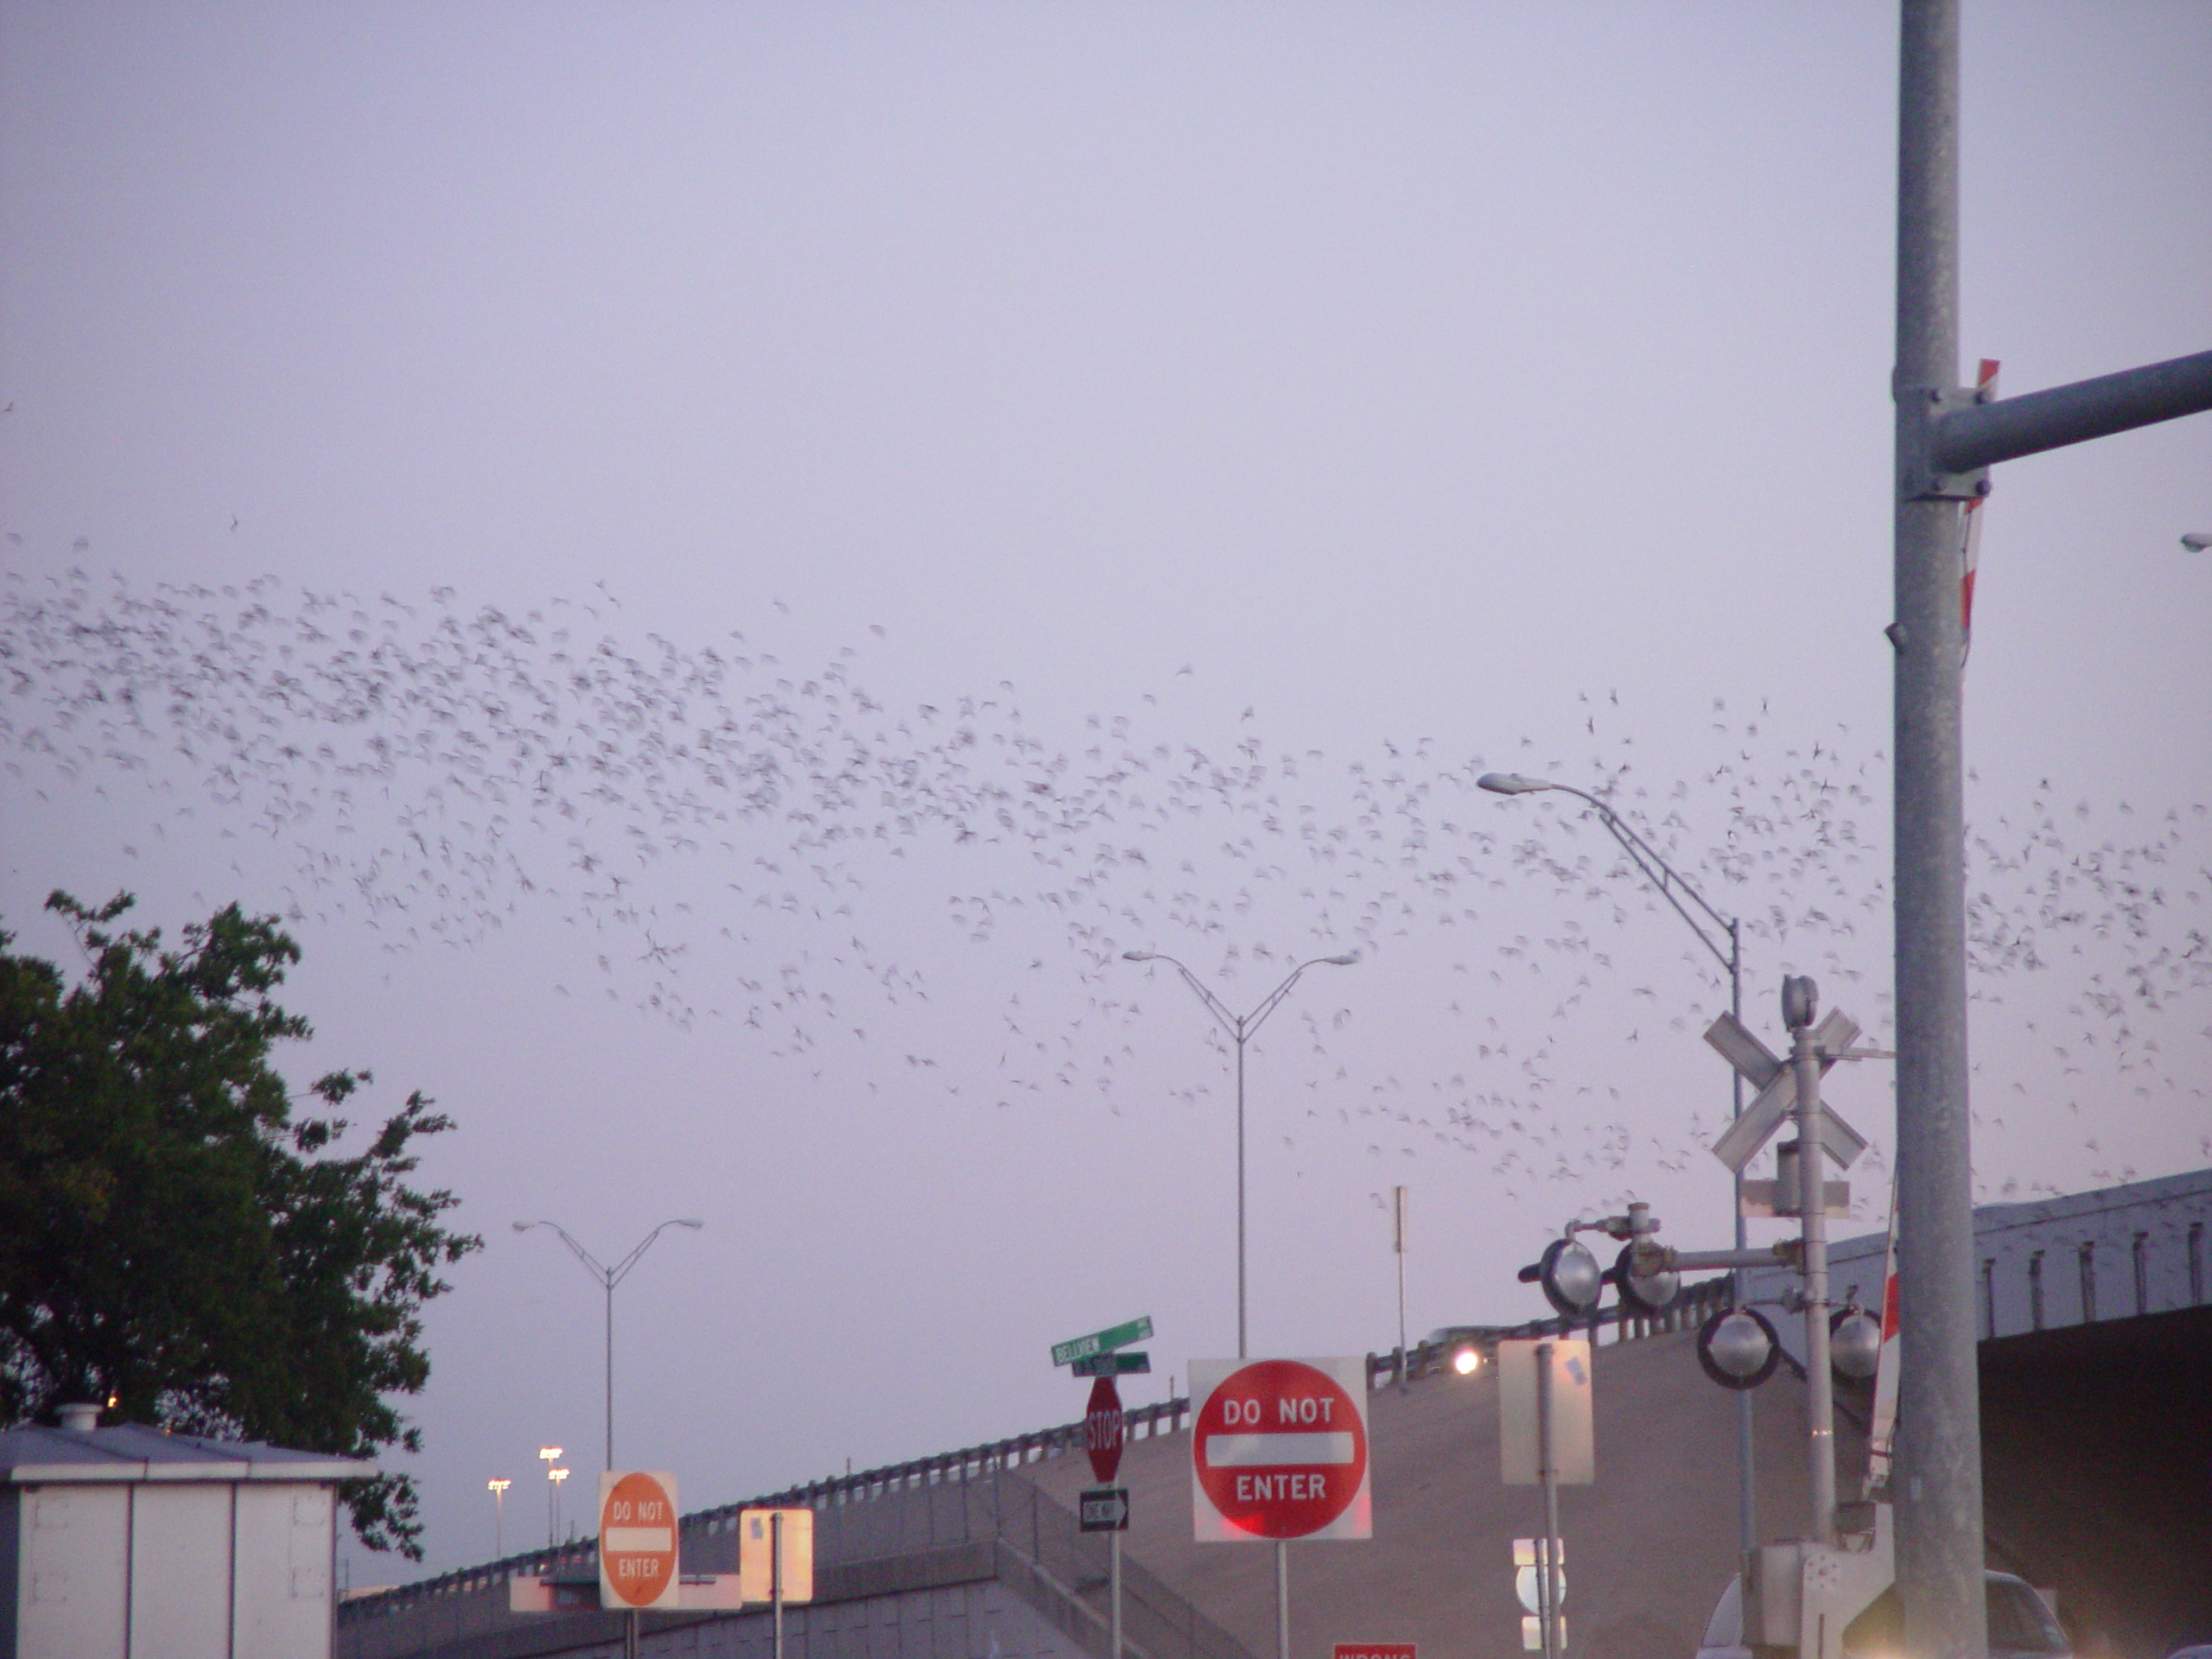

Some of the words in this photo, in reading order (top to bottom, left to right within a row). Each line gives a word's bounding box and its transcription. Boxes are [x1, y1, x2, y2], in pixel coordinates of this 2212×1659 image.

[1224, 1399, 1262, 1425] DO
[1280, 1397, 1335, 1424] NOT
[1088, 1409, 1121, 1450] STOP
[1236, 1474, 1326, 1502] ENTER
[613, 1502, 632, 1521] DO
[638, 1502, 664, 1521] NOT
[619, 1558, 659, 1578] ENTER
